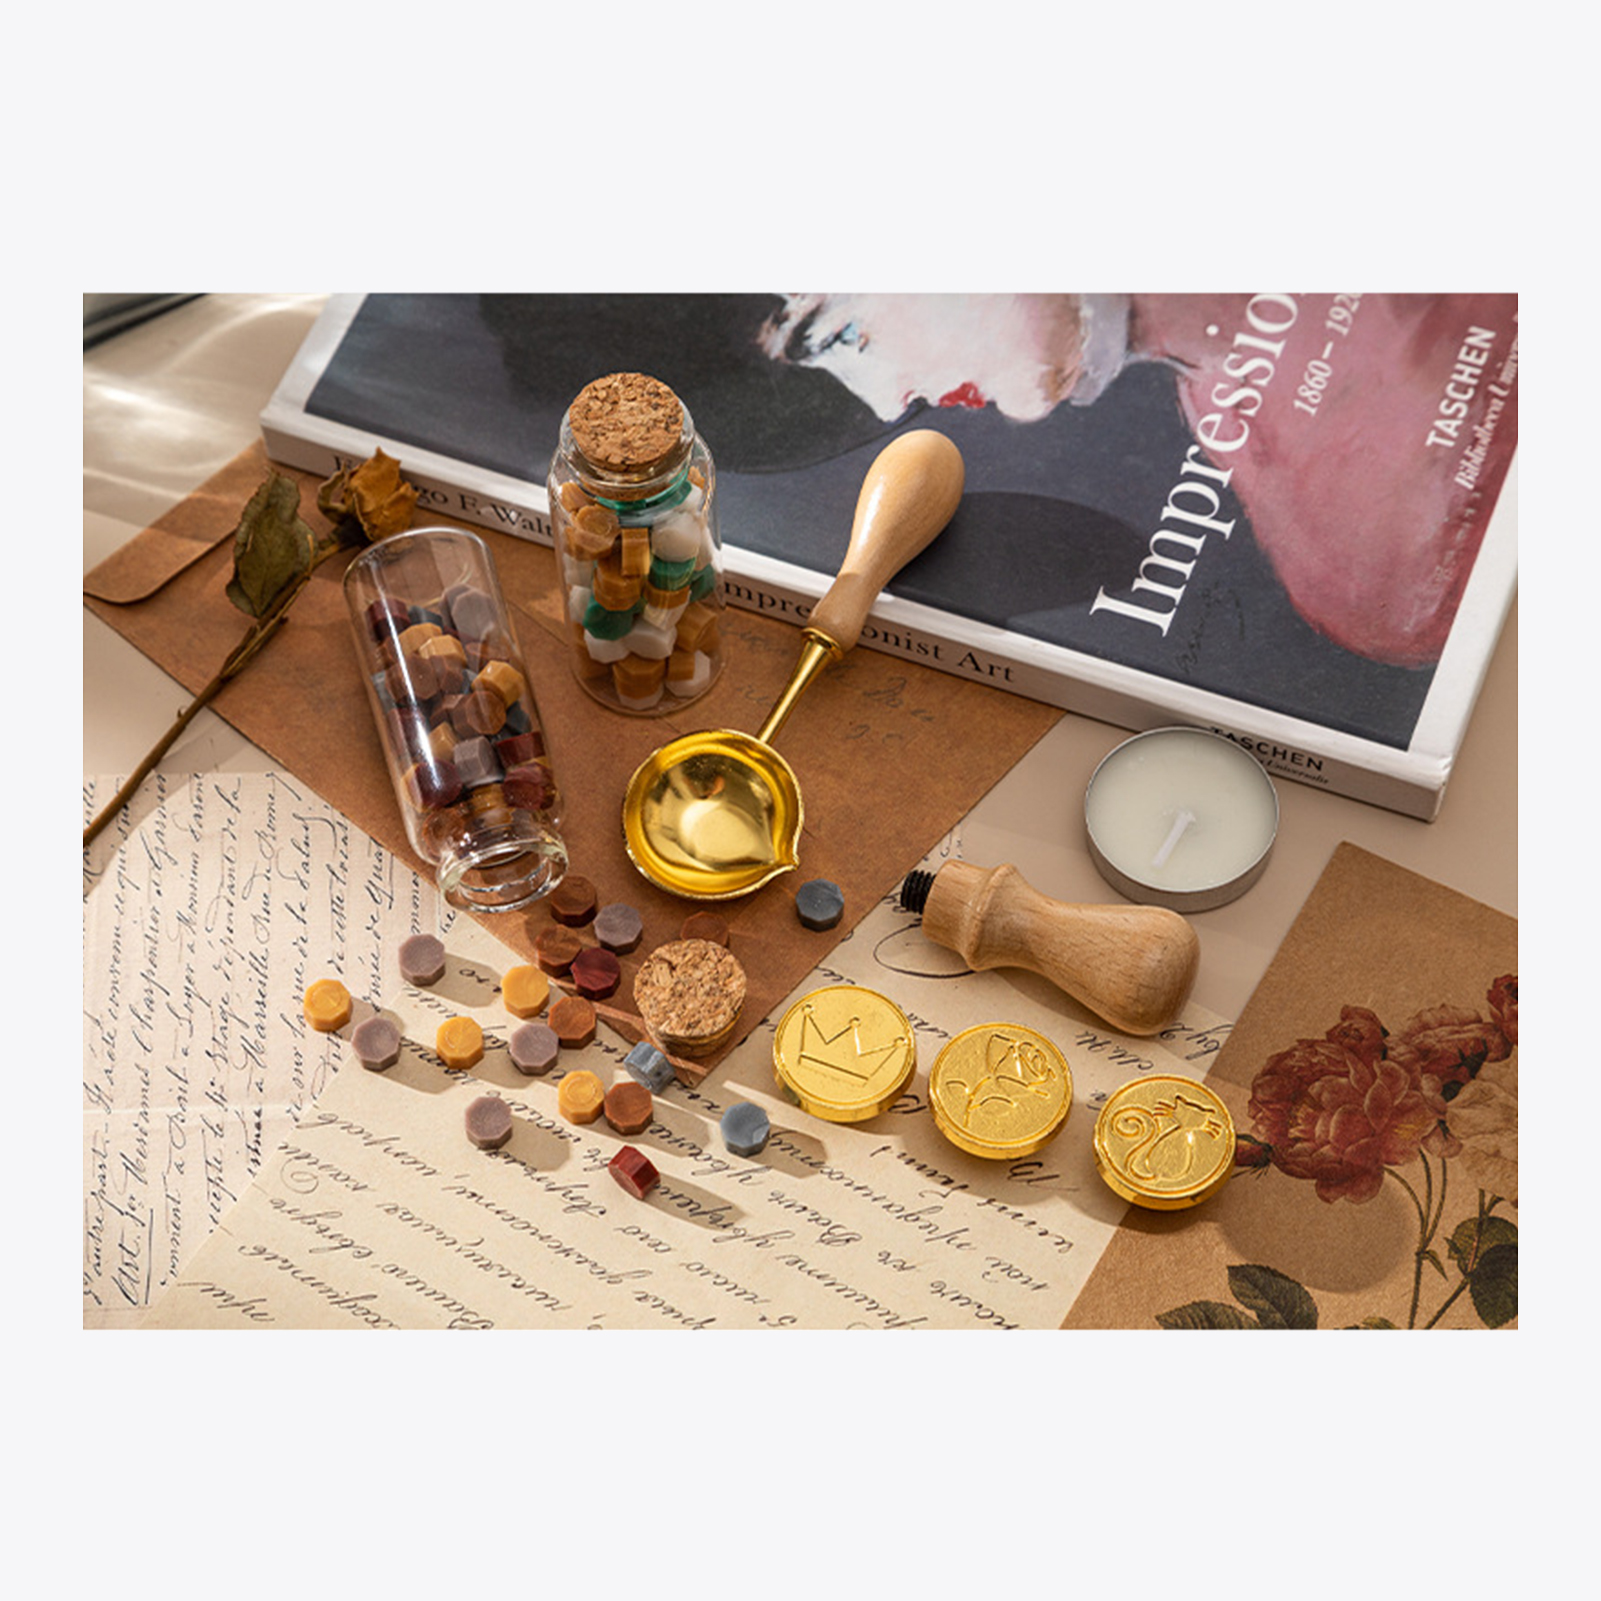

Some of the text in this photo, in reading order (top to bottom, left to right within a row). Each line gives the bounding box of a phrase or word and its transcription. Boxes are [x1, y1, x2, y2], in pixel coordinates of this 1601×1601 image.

[1293, 359, 1334, 416] 1860
[1425, 326, 1497, 448] TASCHEN
[1090, 294, 1305, 637] Impressio
[485, 500, 553, 537] Walt
[724, 580, 944, 662] mpreonist
[956, 651, 1015, 682] Art
[1208, 725, 1324, 772] TASCHEN
